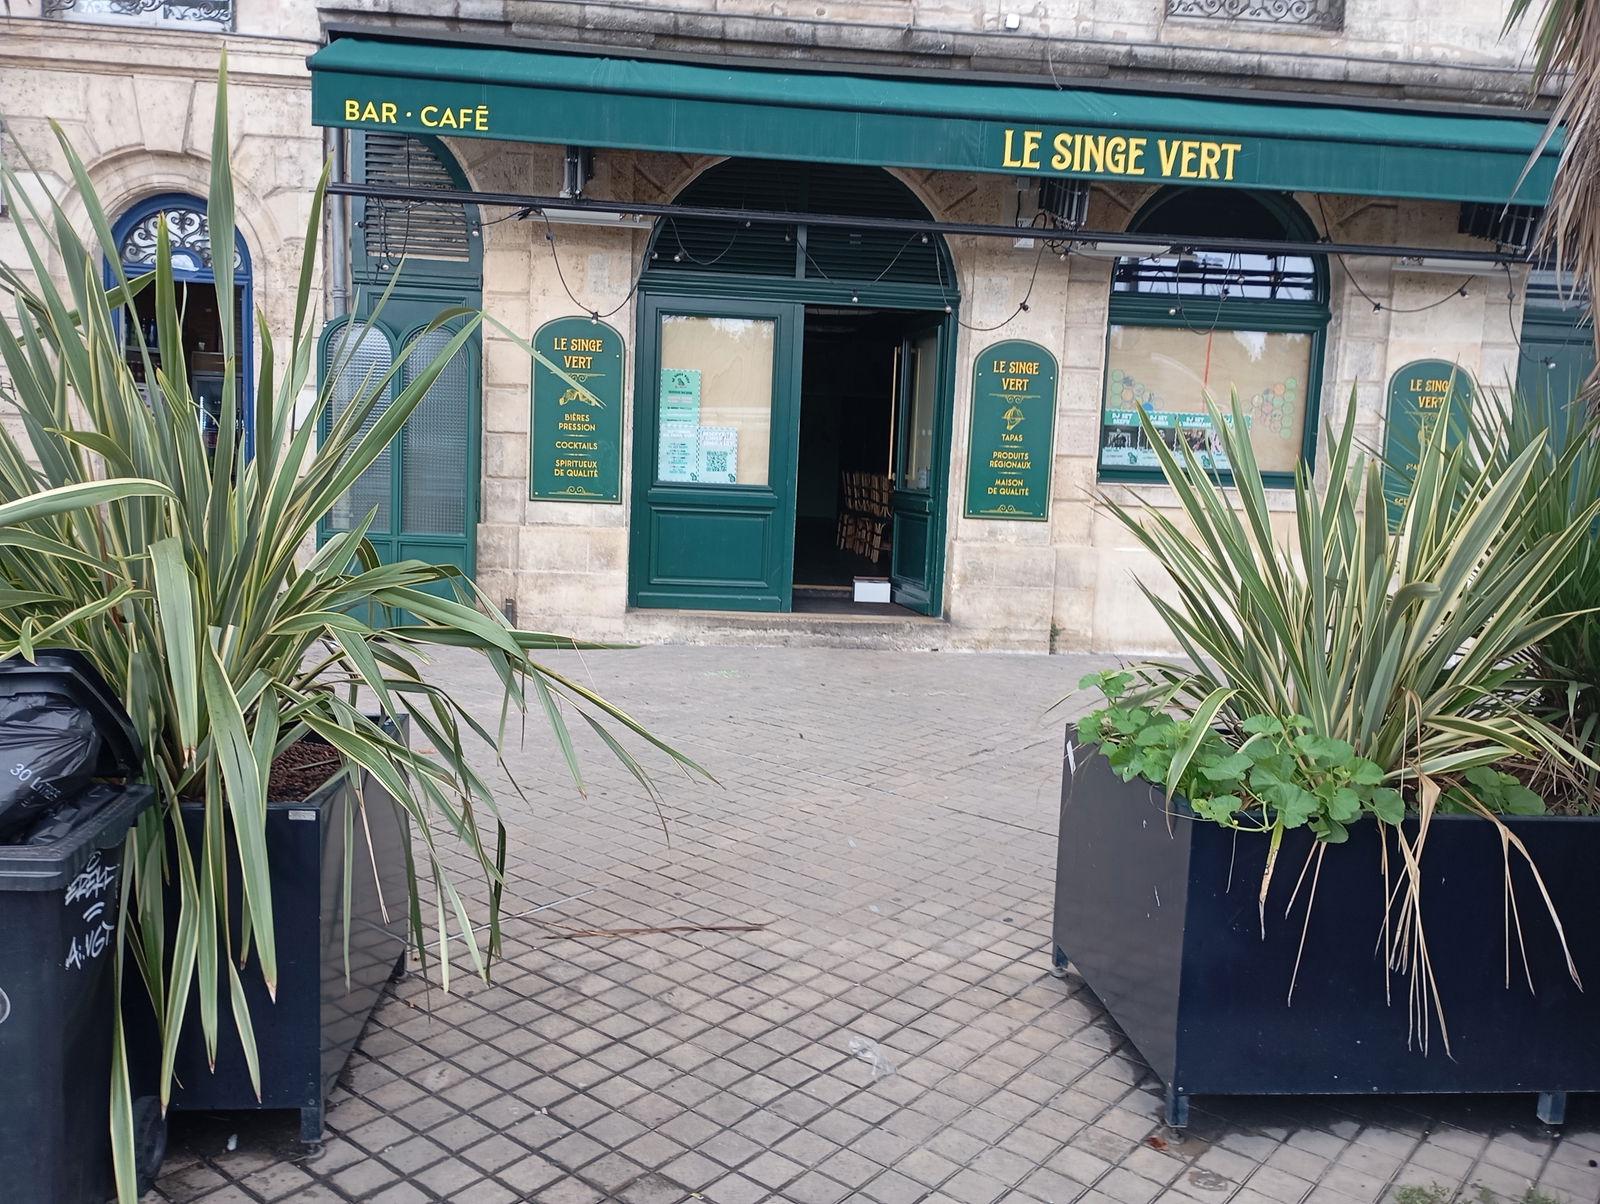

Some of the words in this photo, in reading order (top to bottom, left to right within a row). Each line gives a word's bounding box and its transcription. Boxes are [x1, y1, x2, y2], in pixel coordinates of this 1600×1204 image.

[345, 100, 397, 124] BAR
[1002, 129, 1043, 170] LE
[1051, 132, 1147, 175] SINGE
[1157, 139, 1242, 181] VERT
[553, 337, 568, 351] LE
[570, 338, 603, 352] SINGE
[563, 355, 593, 369] VERT
[993, 360, 1006, 373] LE
[1009, 361, 1040, 375] SINGE
[1002, 378, 1029, 391] VERT
[1410, 379, 1423, 392] LE
[1425, 379, 1452, 393] SING
[564, 412, 590, 422] BIÈRES
[558, 422, 596, 432] PRESSION
[1001, 433, 1023, 442] TAPAS
[555, 441, 598, 450] COCKTAILS
[992, 451, 1029, 460] PRODUITS
[555, 459, 598, 468] SPIRITUEUX
[554, 468, 564, 477] DE
[566, 468, 598, 478] QUALITÉ
[994, 479, 1024, 487] MAISON
[987, 487, 998, 495] DE
[999, 487, 1029, 496] QUALITÉ
[9, 763, 32, 781] 30
